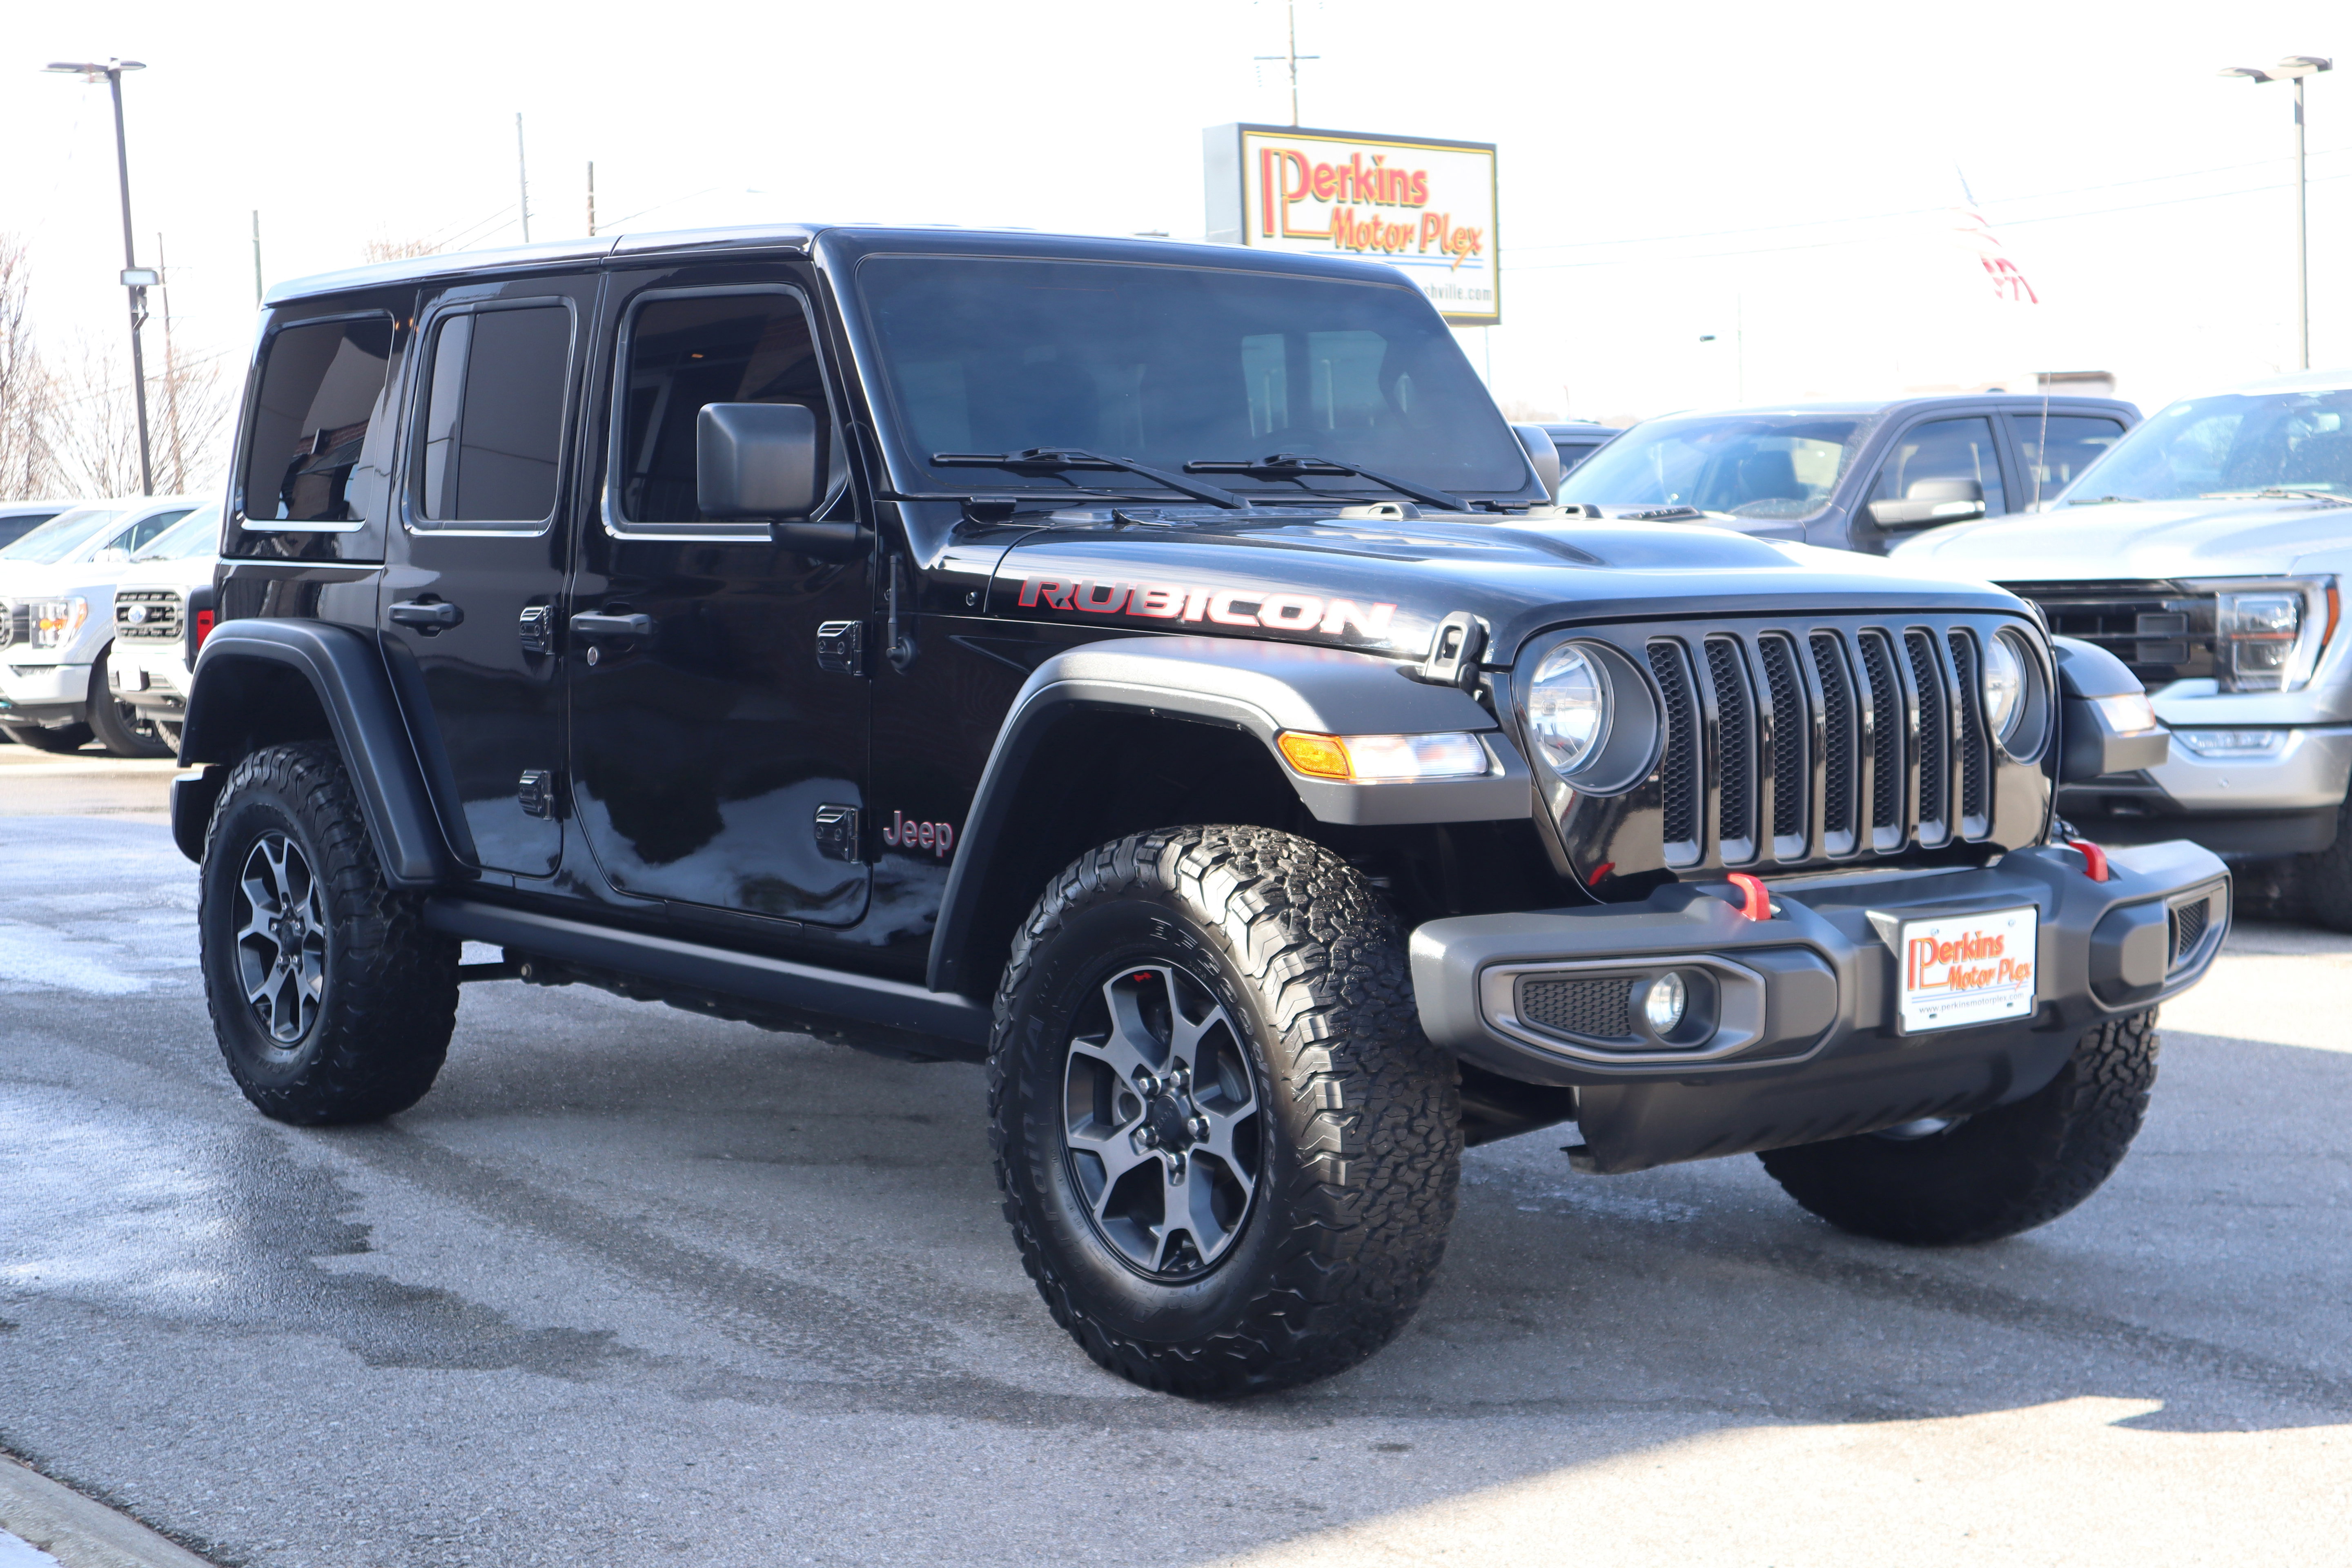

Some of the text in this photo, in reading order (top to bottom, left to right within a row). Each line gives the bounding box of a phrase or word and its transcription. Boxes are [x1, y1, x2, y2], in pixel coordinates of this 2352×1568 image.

[1261, 147, 1429, 237] Perkins
[1331, 206, 1485, 271] Motor Plex
[1018, 575, 1398, 639] RUBICON
[883, 810, 953, 857] Jeep
[1908, 930, 2005, 991] Perkins
[1949, 957, 2033, 992] Motor Plex
[1919, 993, 2024, 1013] www.perkinsmotorplex.com
